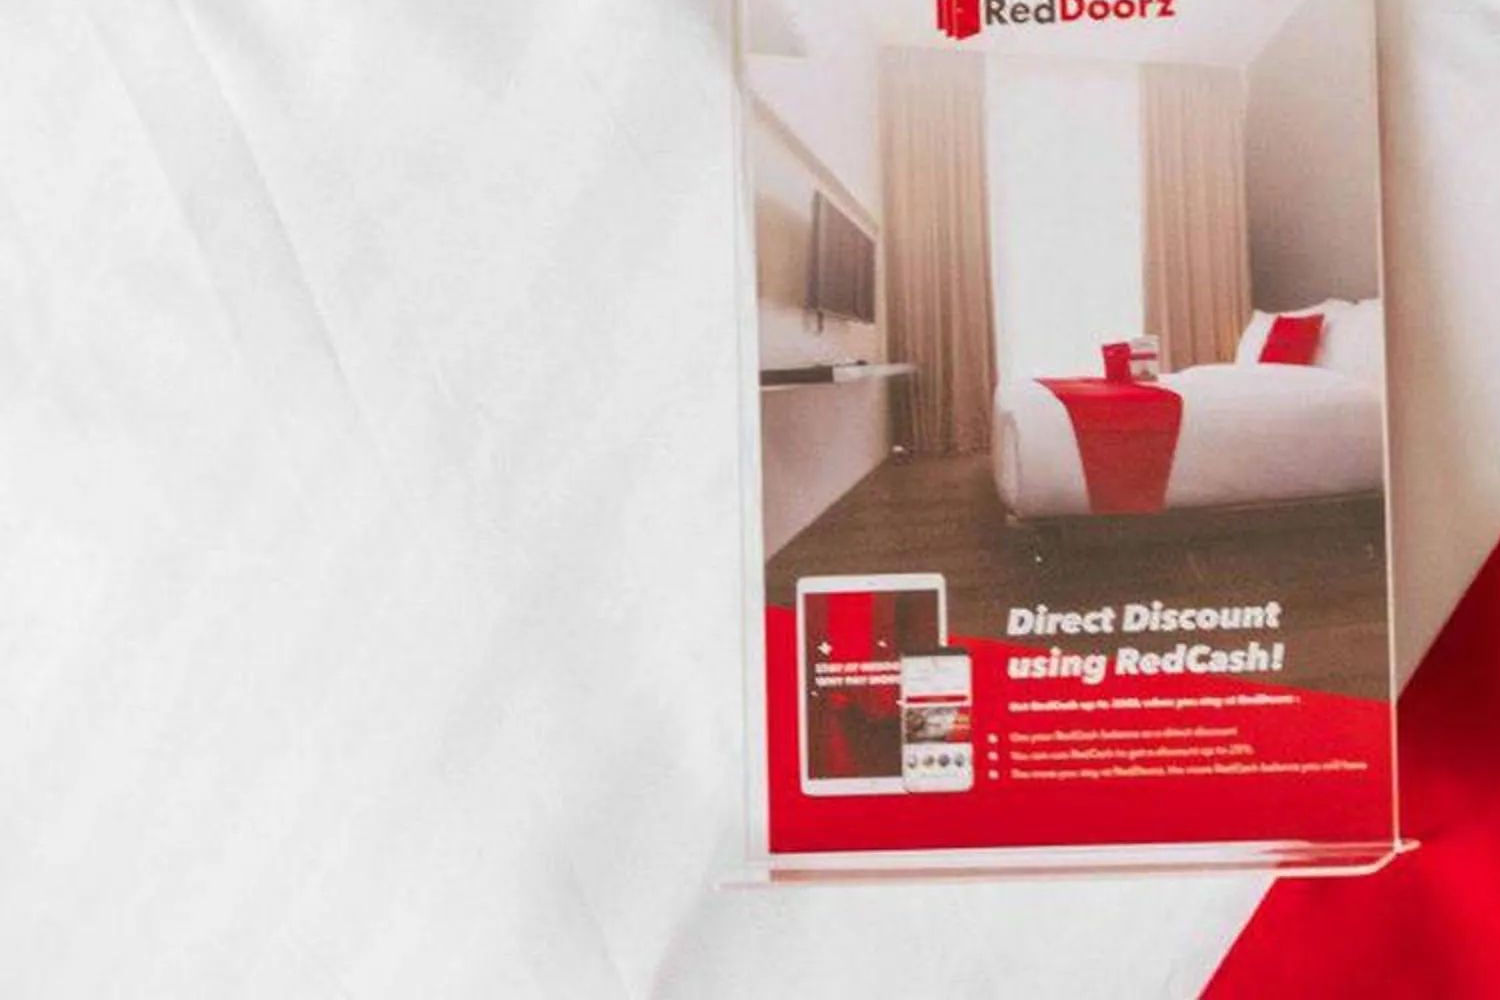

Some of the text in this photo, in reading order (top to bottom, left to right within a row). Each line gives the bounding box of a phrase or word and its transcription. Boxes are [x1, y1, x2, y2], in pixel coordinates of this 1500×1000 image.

[1006, 600, 1281, 636] Direct Discount
[1007, 641, 1285, 685] using RedCash!
